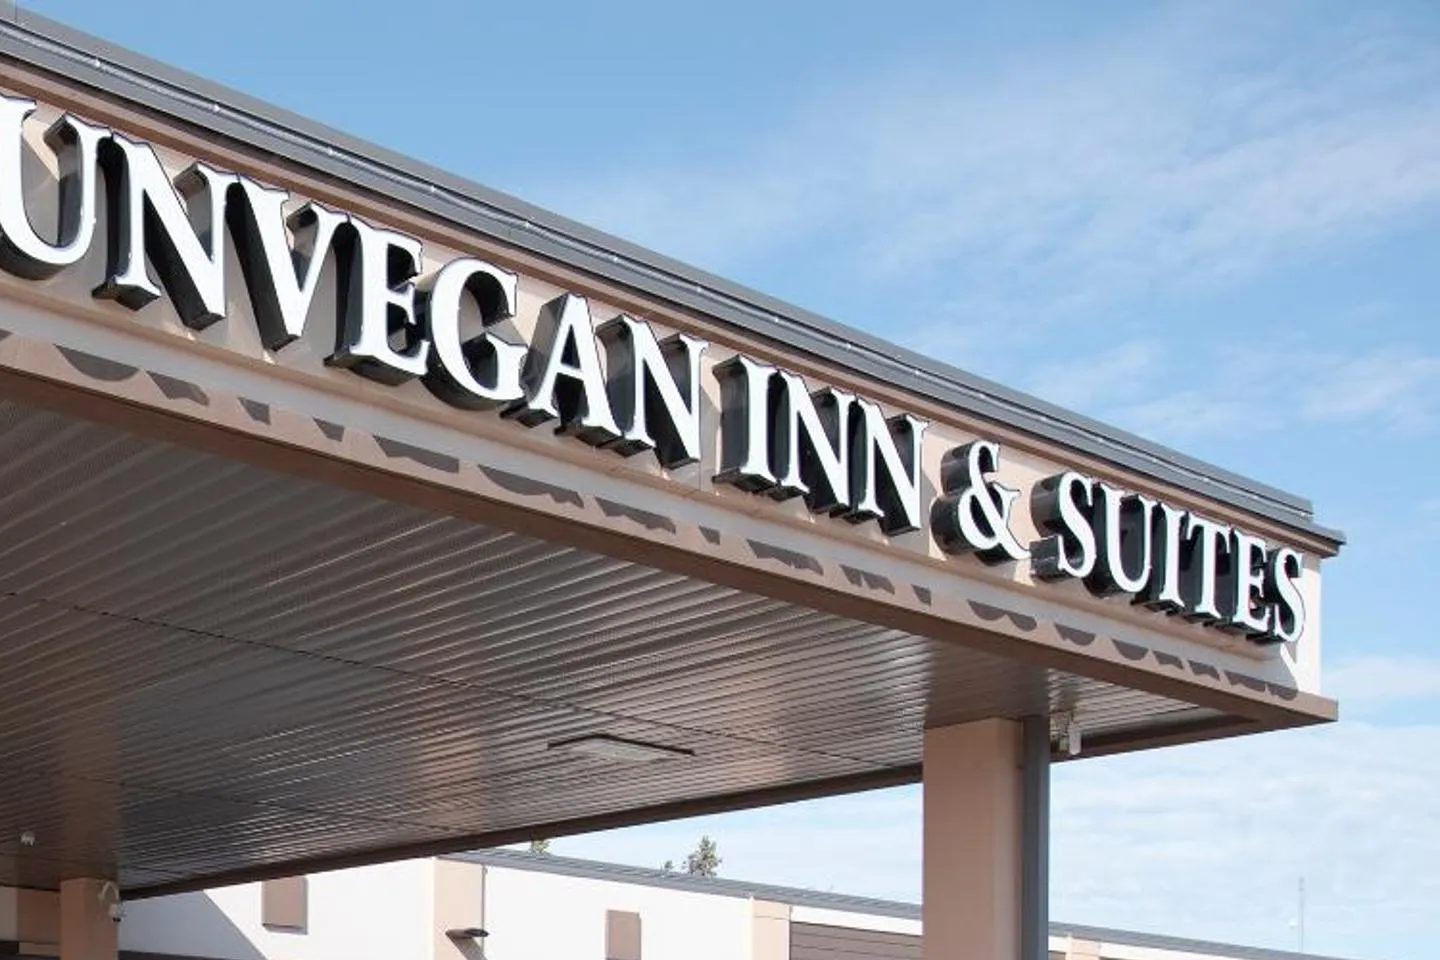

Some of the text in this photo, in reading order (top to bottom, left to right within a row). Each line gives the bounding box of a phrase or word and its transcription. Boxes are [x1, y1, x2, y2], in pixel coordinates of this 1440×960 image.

[724, 354, 930, 533] INN
[946, 440, 1032, 560] &
[1044, 472, 1306, 644] SUITES
